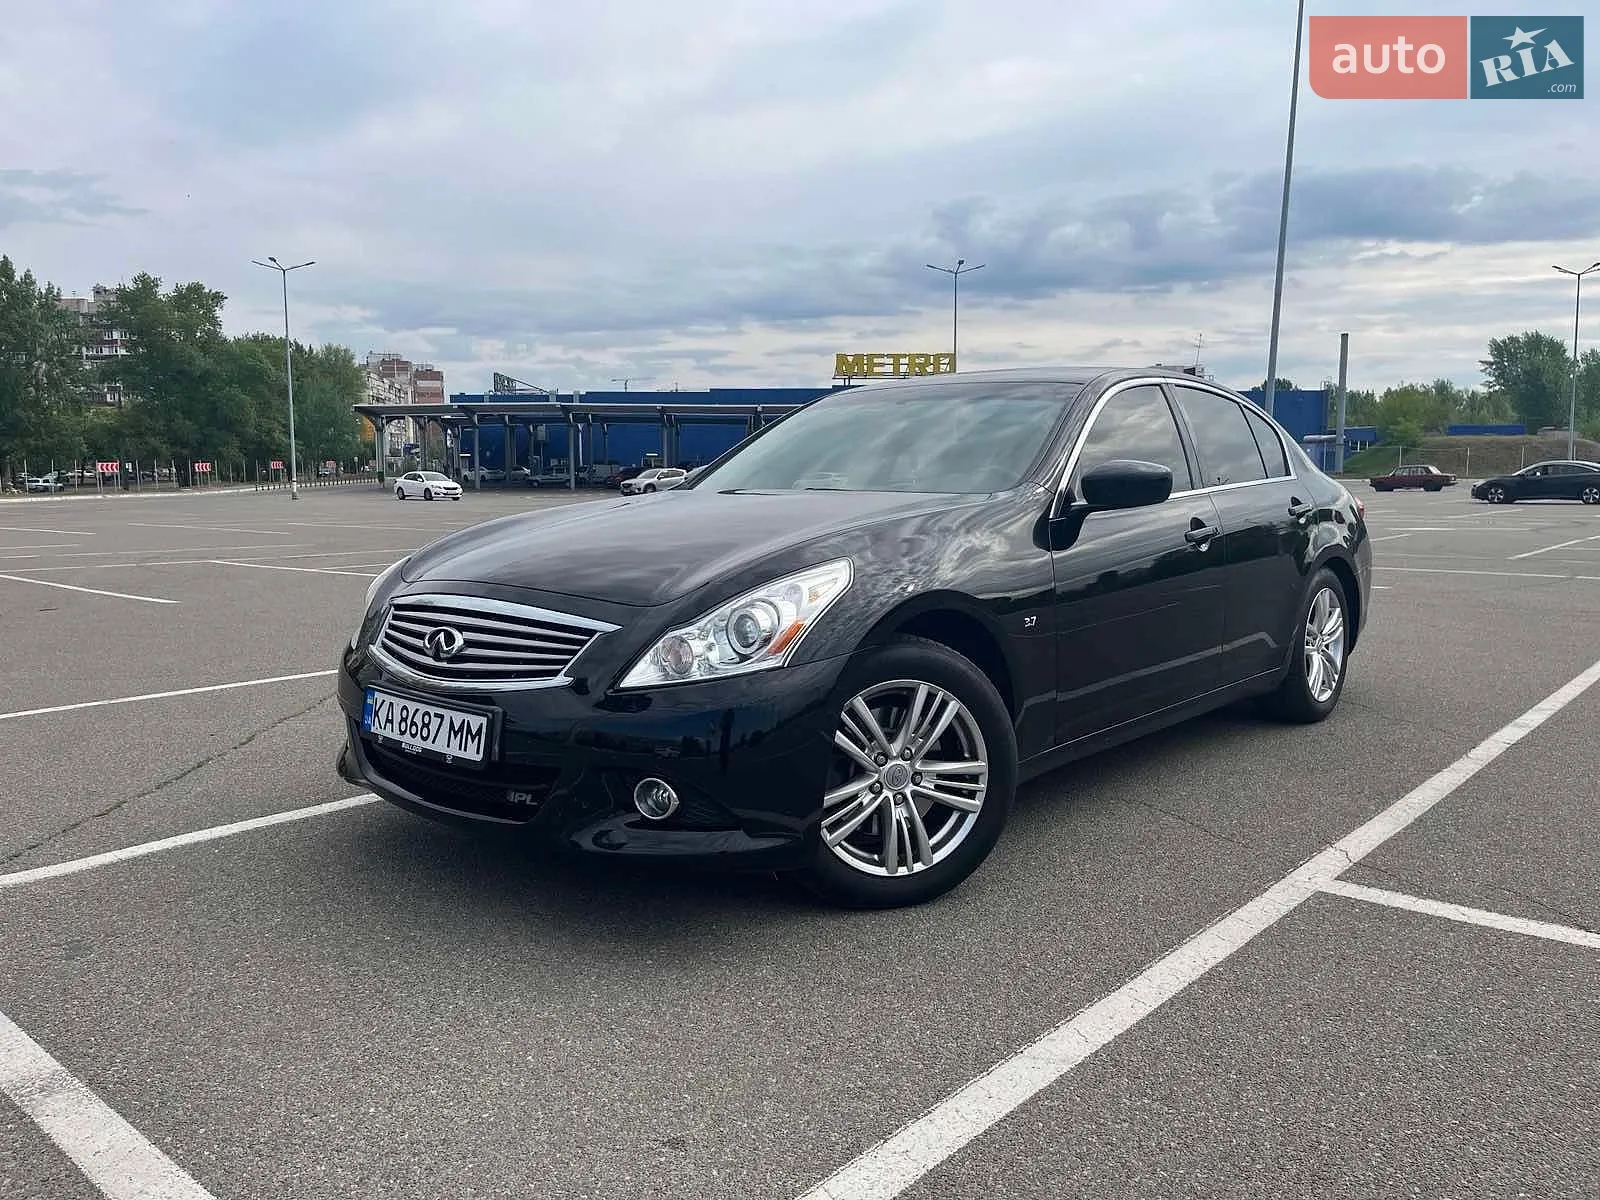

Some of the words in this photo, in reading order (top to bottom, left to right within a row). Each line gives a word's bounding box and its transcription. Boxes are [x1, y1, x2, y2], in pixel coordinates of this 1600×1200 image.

[835, 352, 956, 376] METRO
[372, 697, 394, 733] KA
[398, 704, 445, 745] 8687
[447, 715, 483, 755] MM
